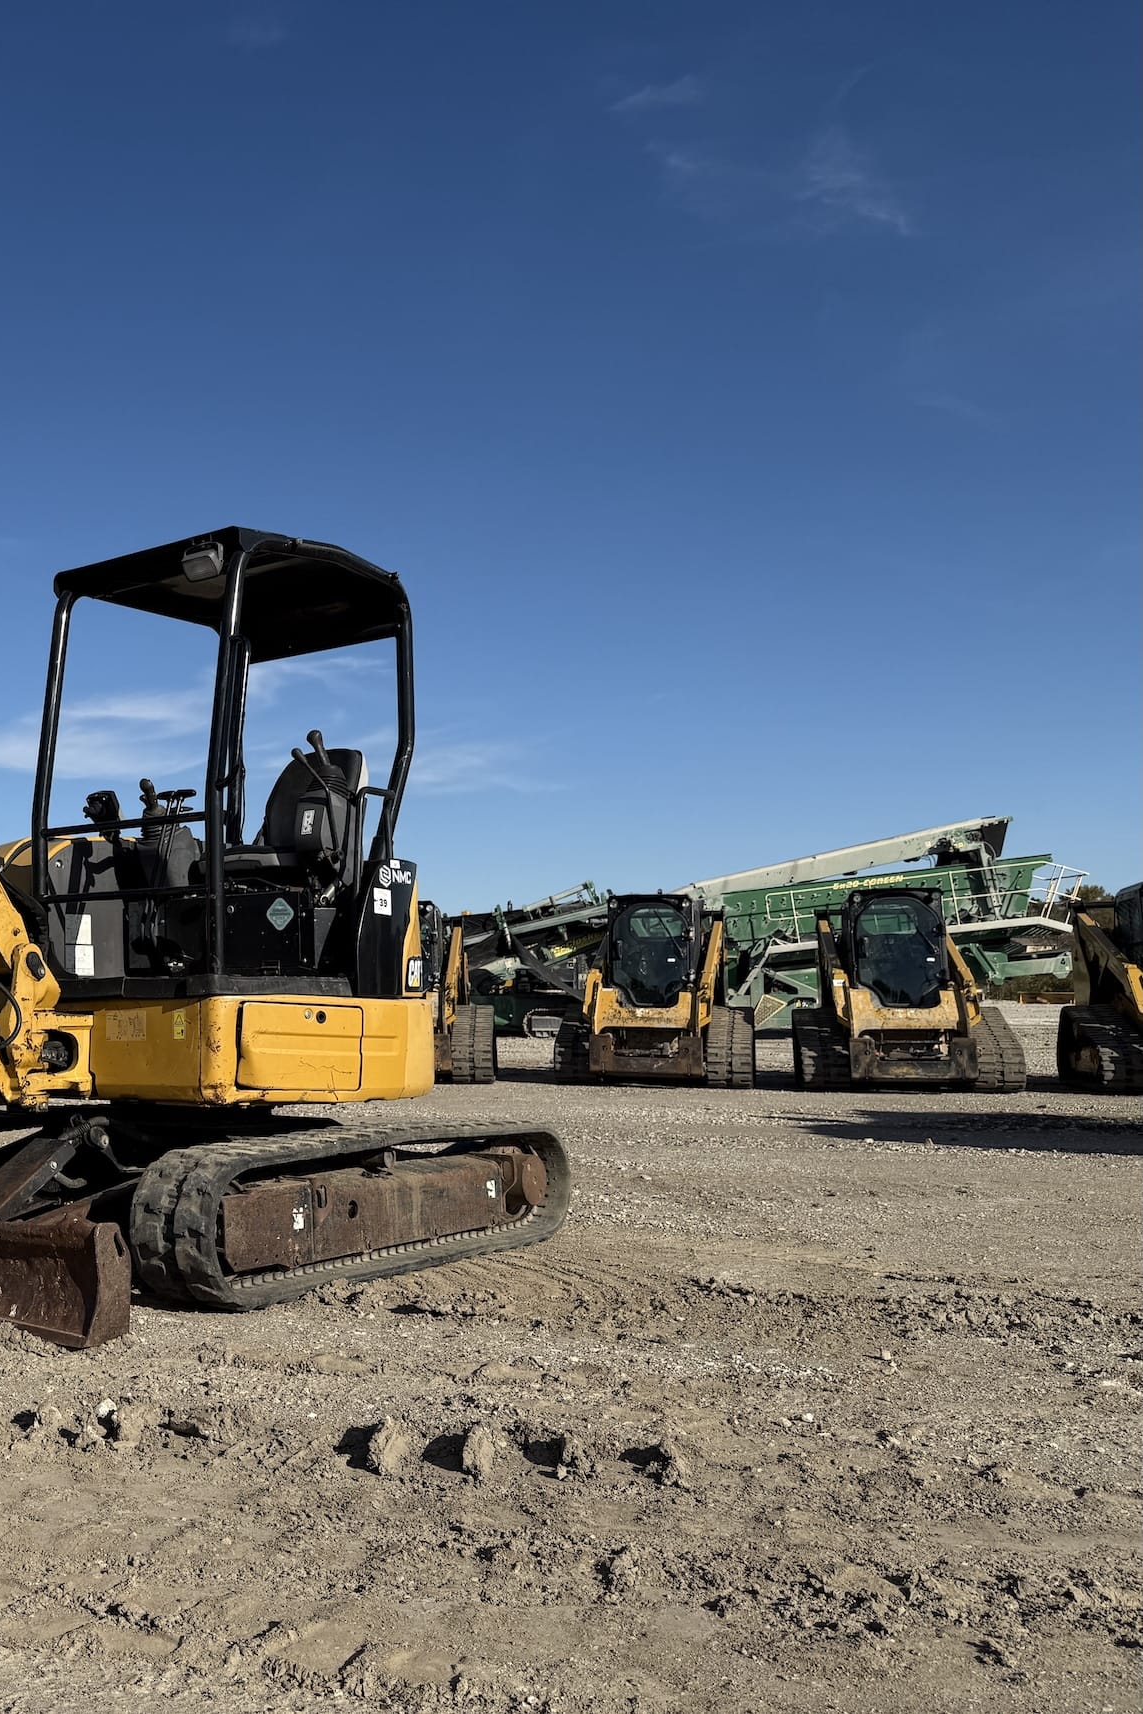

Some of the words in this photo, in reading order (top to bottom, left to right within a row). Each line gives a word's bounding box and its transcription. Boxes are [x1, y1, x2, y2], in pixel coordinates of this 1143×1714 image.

[391, 869, 412, 885] NMC
[379, 898, 388, 908] 39
[408, 959, 423, 988] CAT
